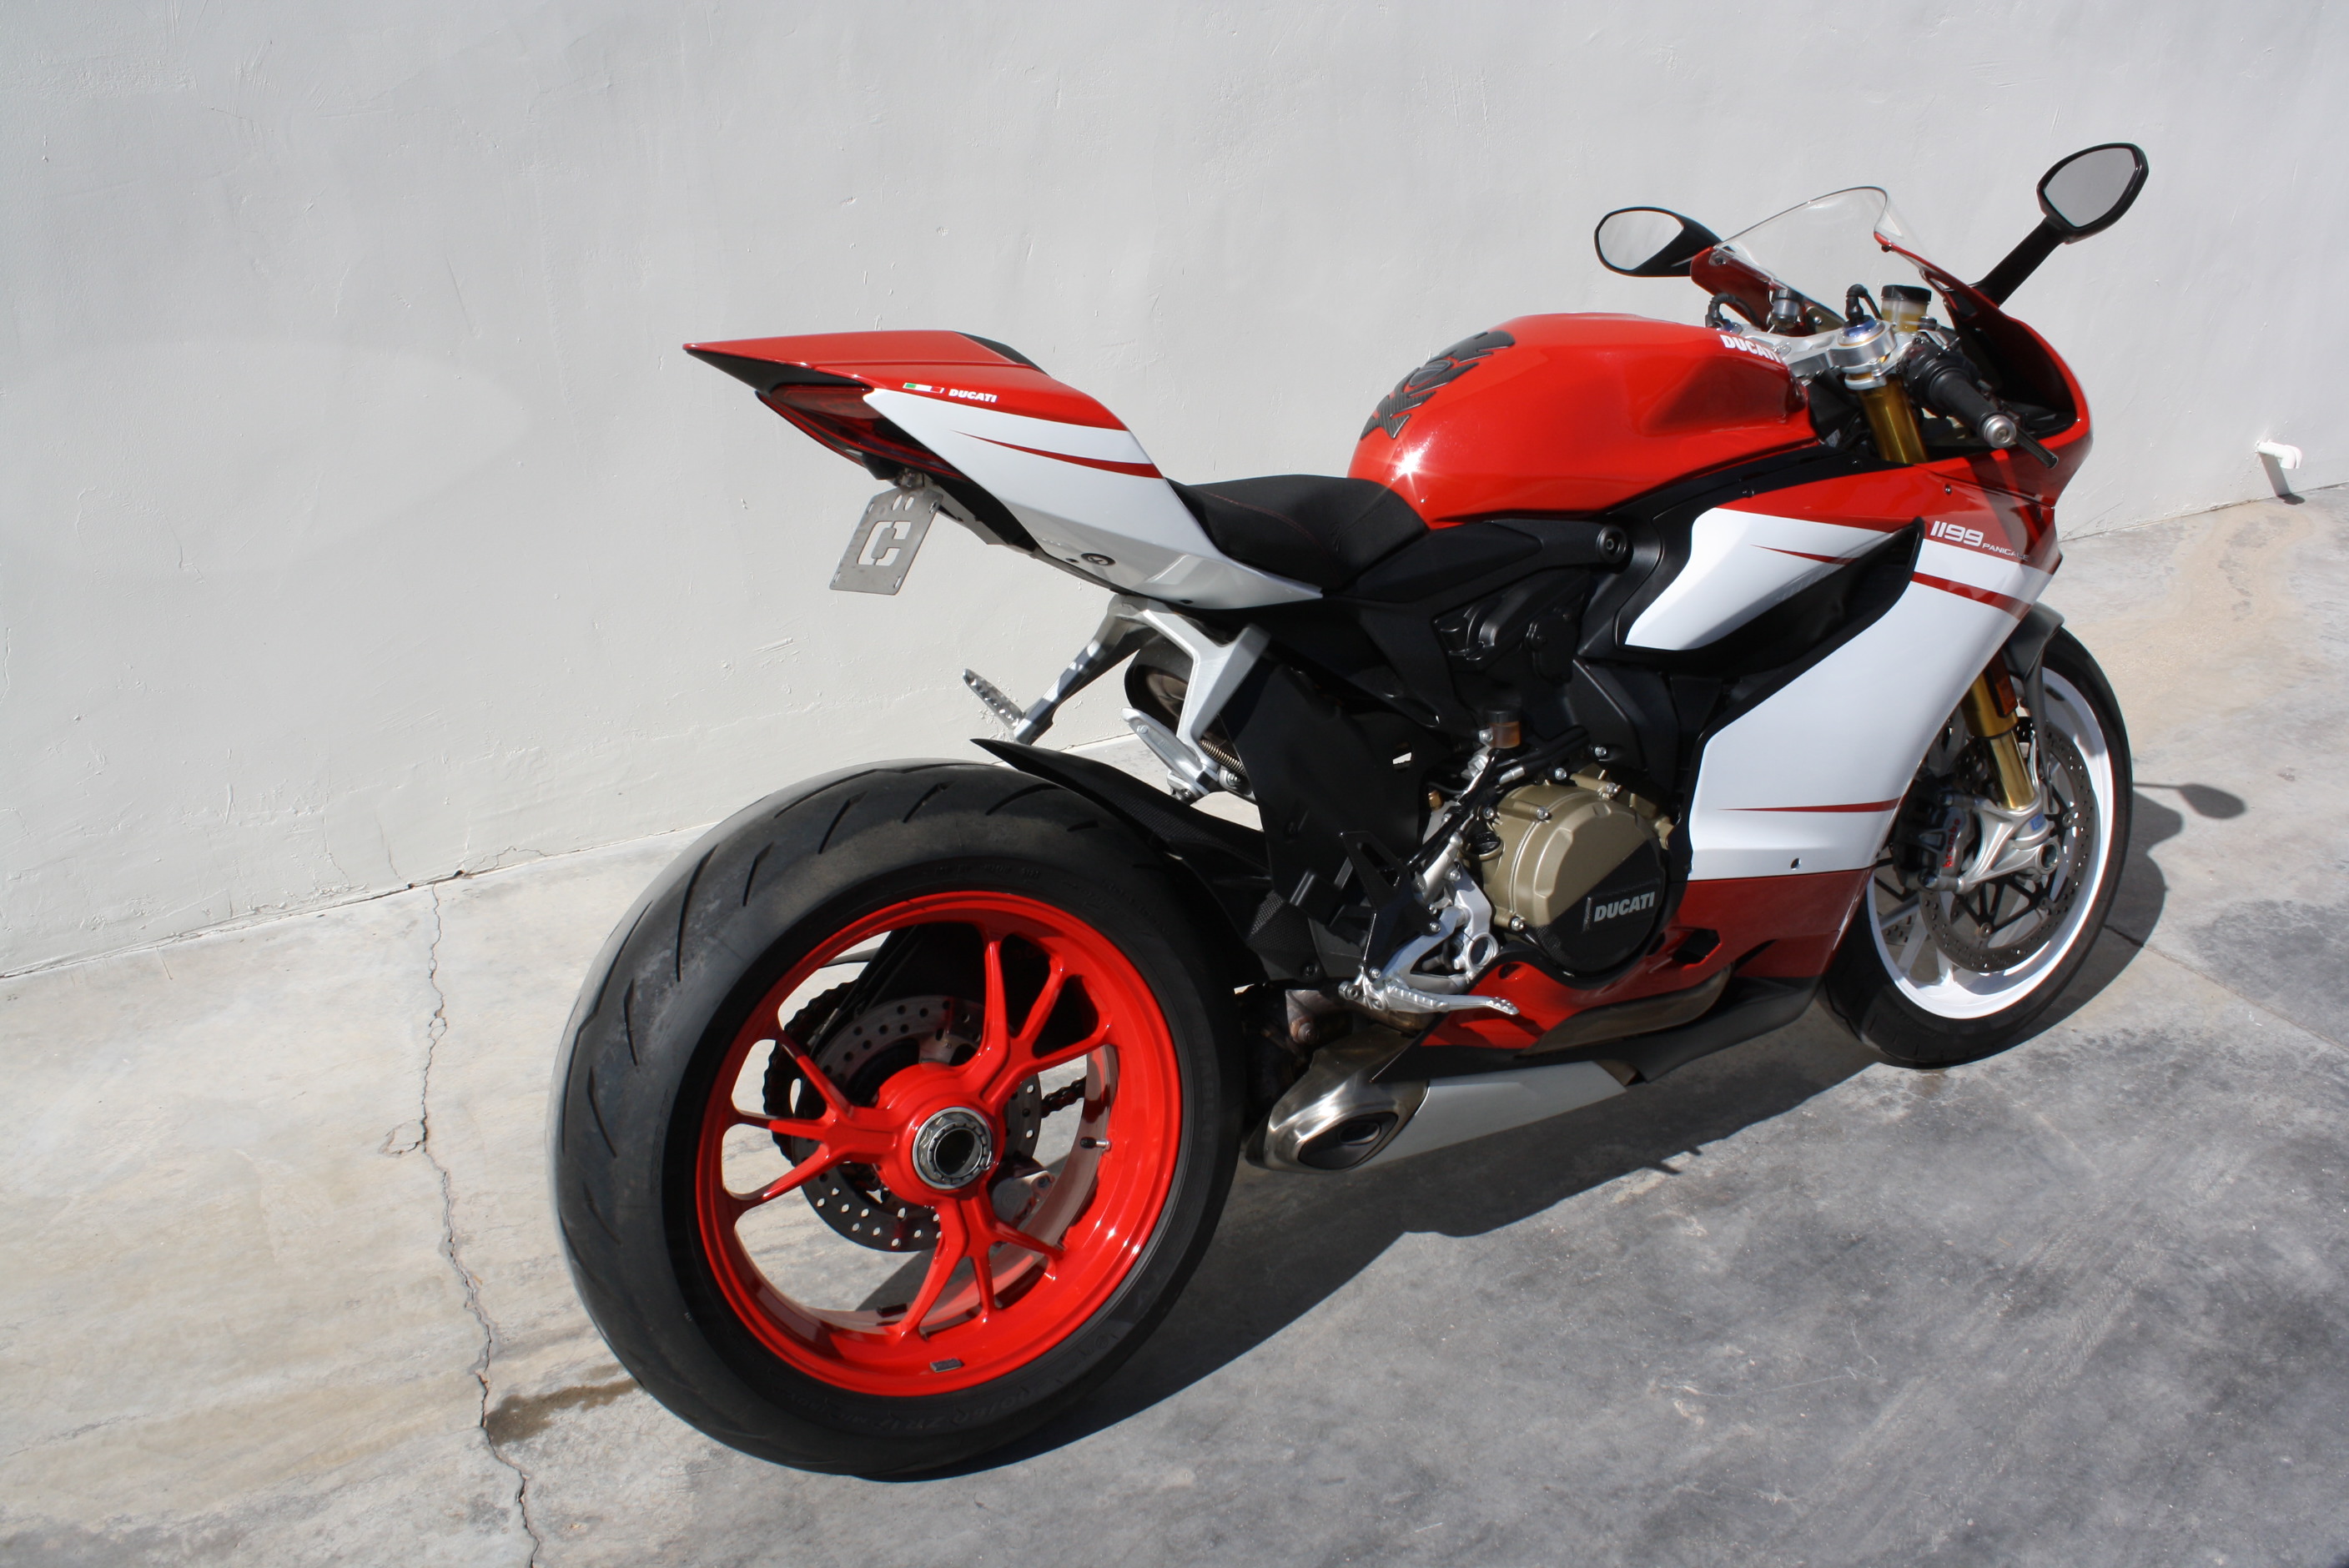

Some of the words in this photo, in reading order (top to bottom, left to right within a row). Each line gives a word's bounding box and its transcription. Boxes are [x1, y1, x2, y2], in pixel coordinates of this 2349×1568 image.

[1719, 334, 1782, 364] DUCATI
[948, 389, 998, 403] DUCATI
[1929, 520, 1984, 547] 1199
[1982, 543, 2030, 561] PANIGALE
[1594, 892, 1655, 922] DUCATI
